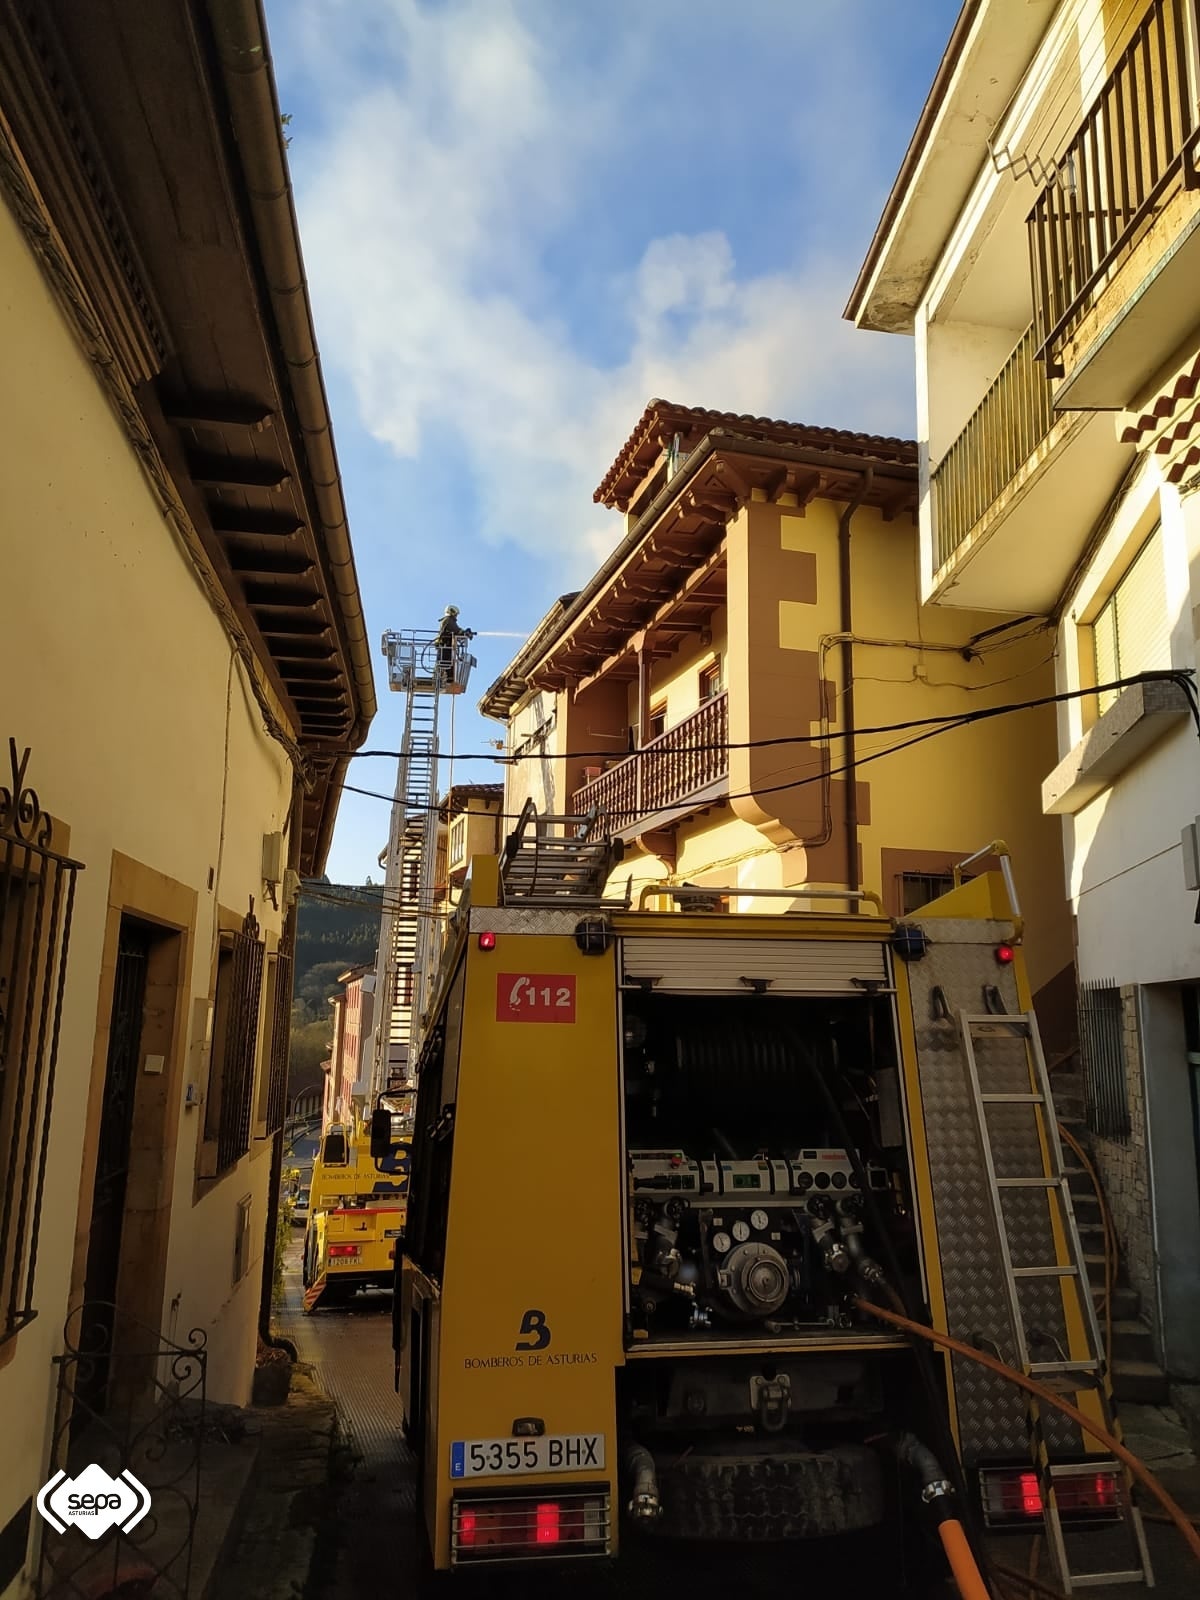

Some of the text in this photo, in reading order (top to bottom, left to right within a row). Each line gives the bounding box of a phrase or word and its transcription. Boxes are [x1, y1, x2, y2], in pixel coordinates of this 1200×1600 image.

[525, 986, 571, 1007] 112
[464, 1352, 598, 1369] BOMBEROS DE ASTURIAS
[470, 1440, 538, 1472] 5355
[549, 1437, 598, 1467] BHX
